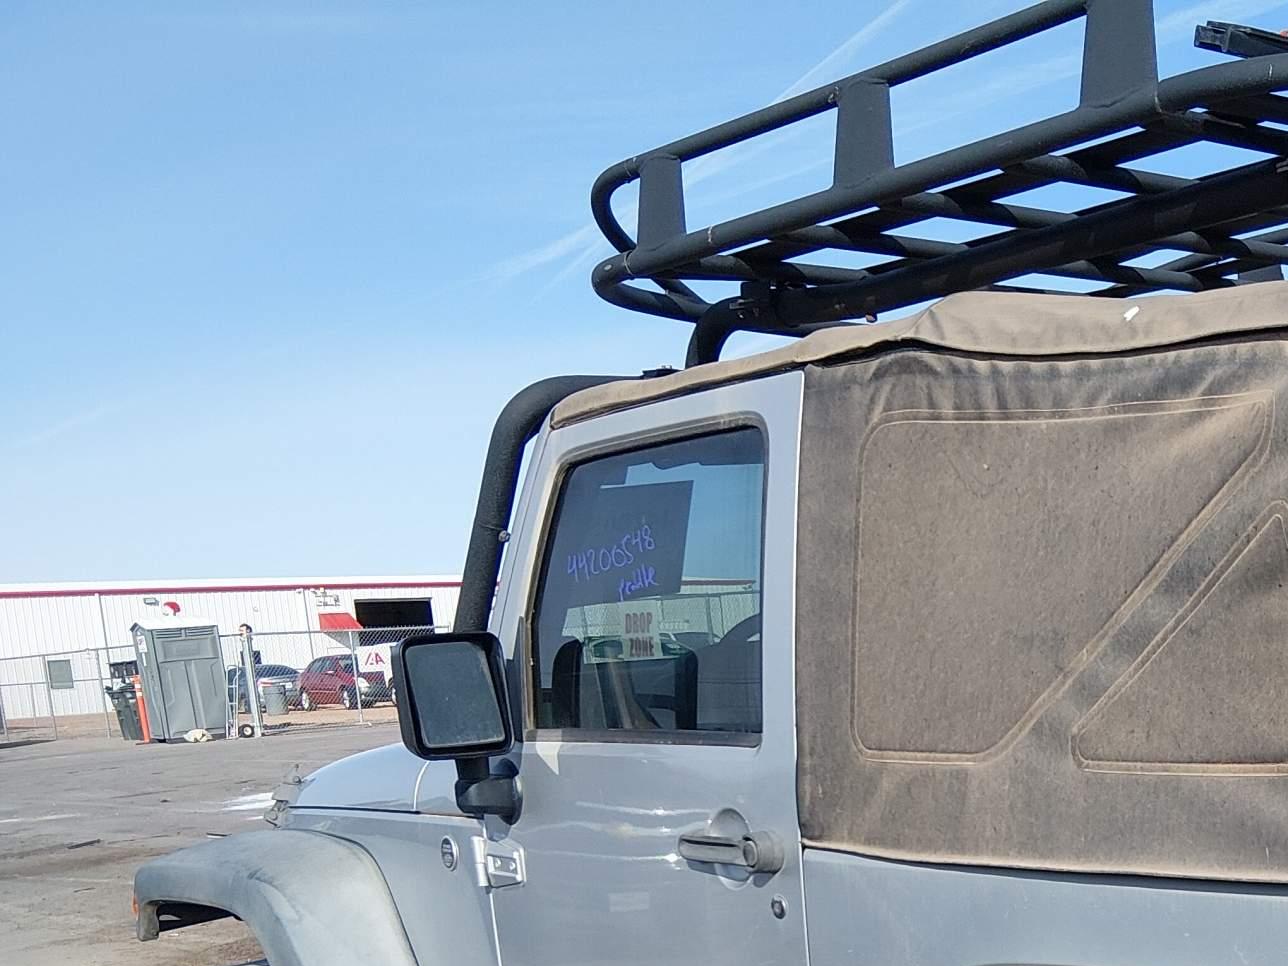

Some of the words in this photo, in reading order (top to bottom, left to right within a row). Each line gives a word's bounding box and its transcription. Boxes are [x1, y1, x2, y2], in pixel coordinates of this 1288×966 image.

[567, 524, 656, 582] 44200548
[625, 611, 653, 634] DROP
[630, 636, 655, 657] ZONE
